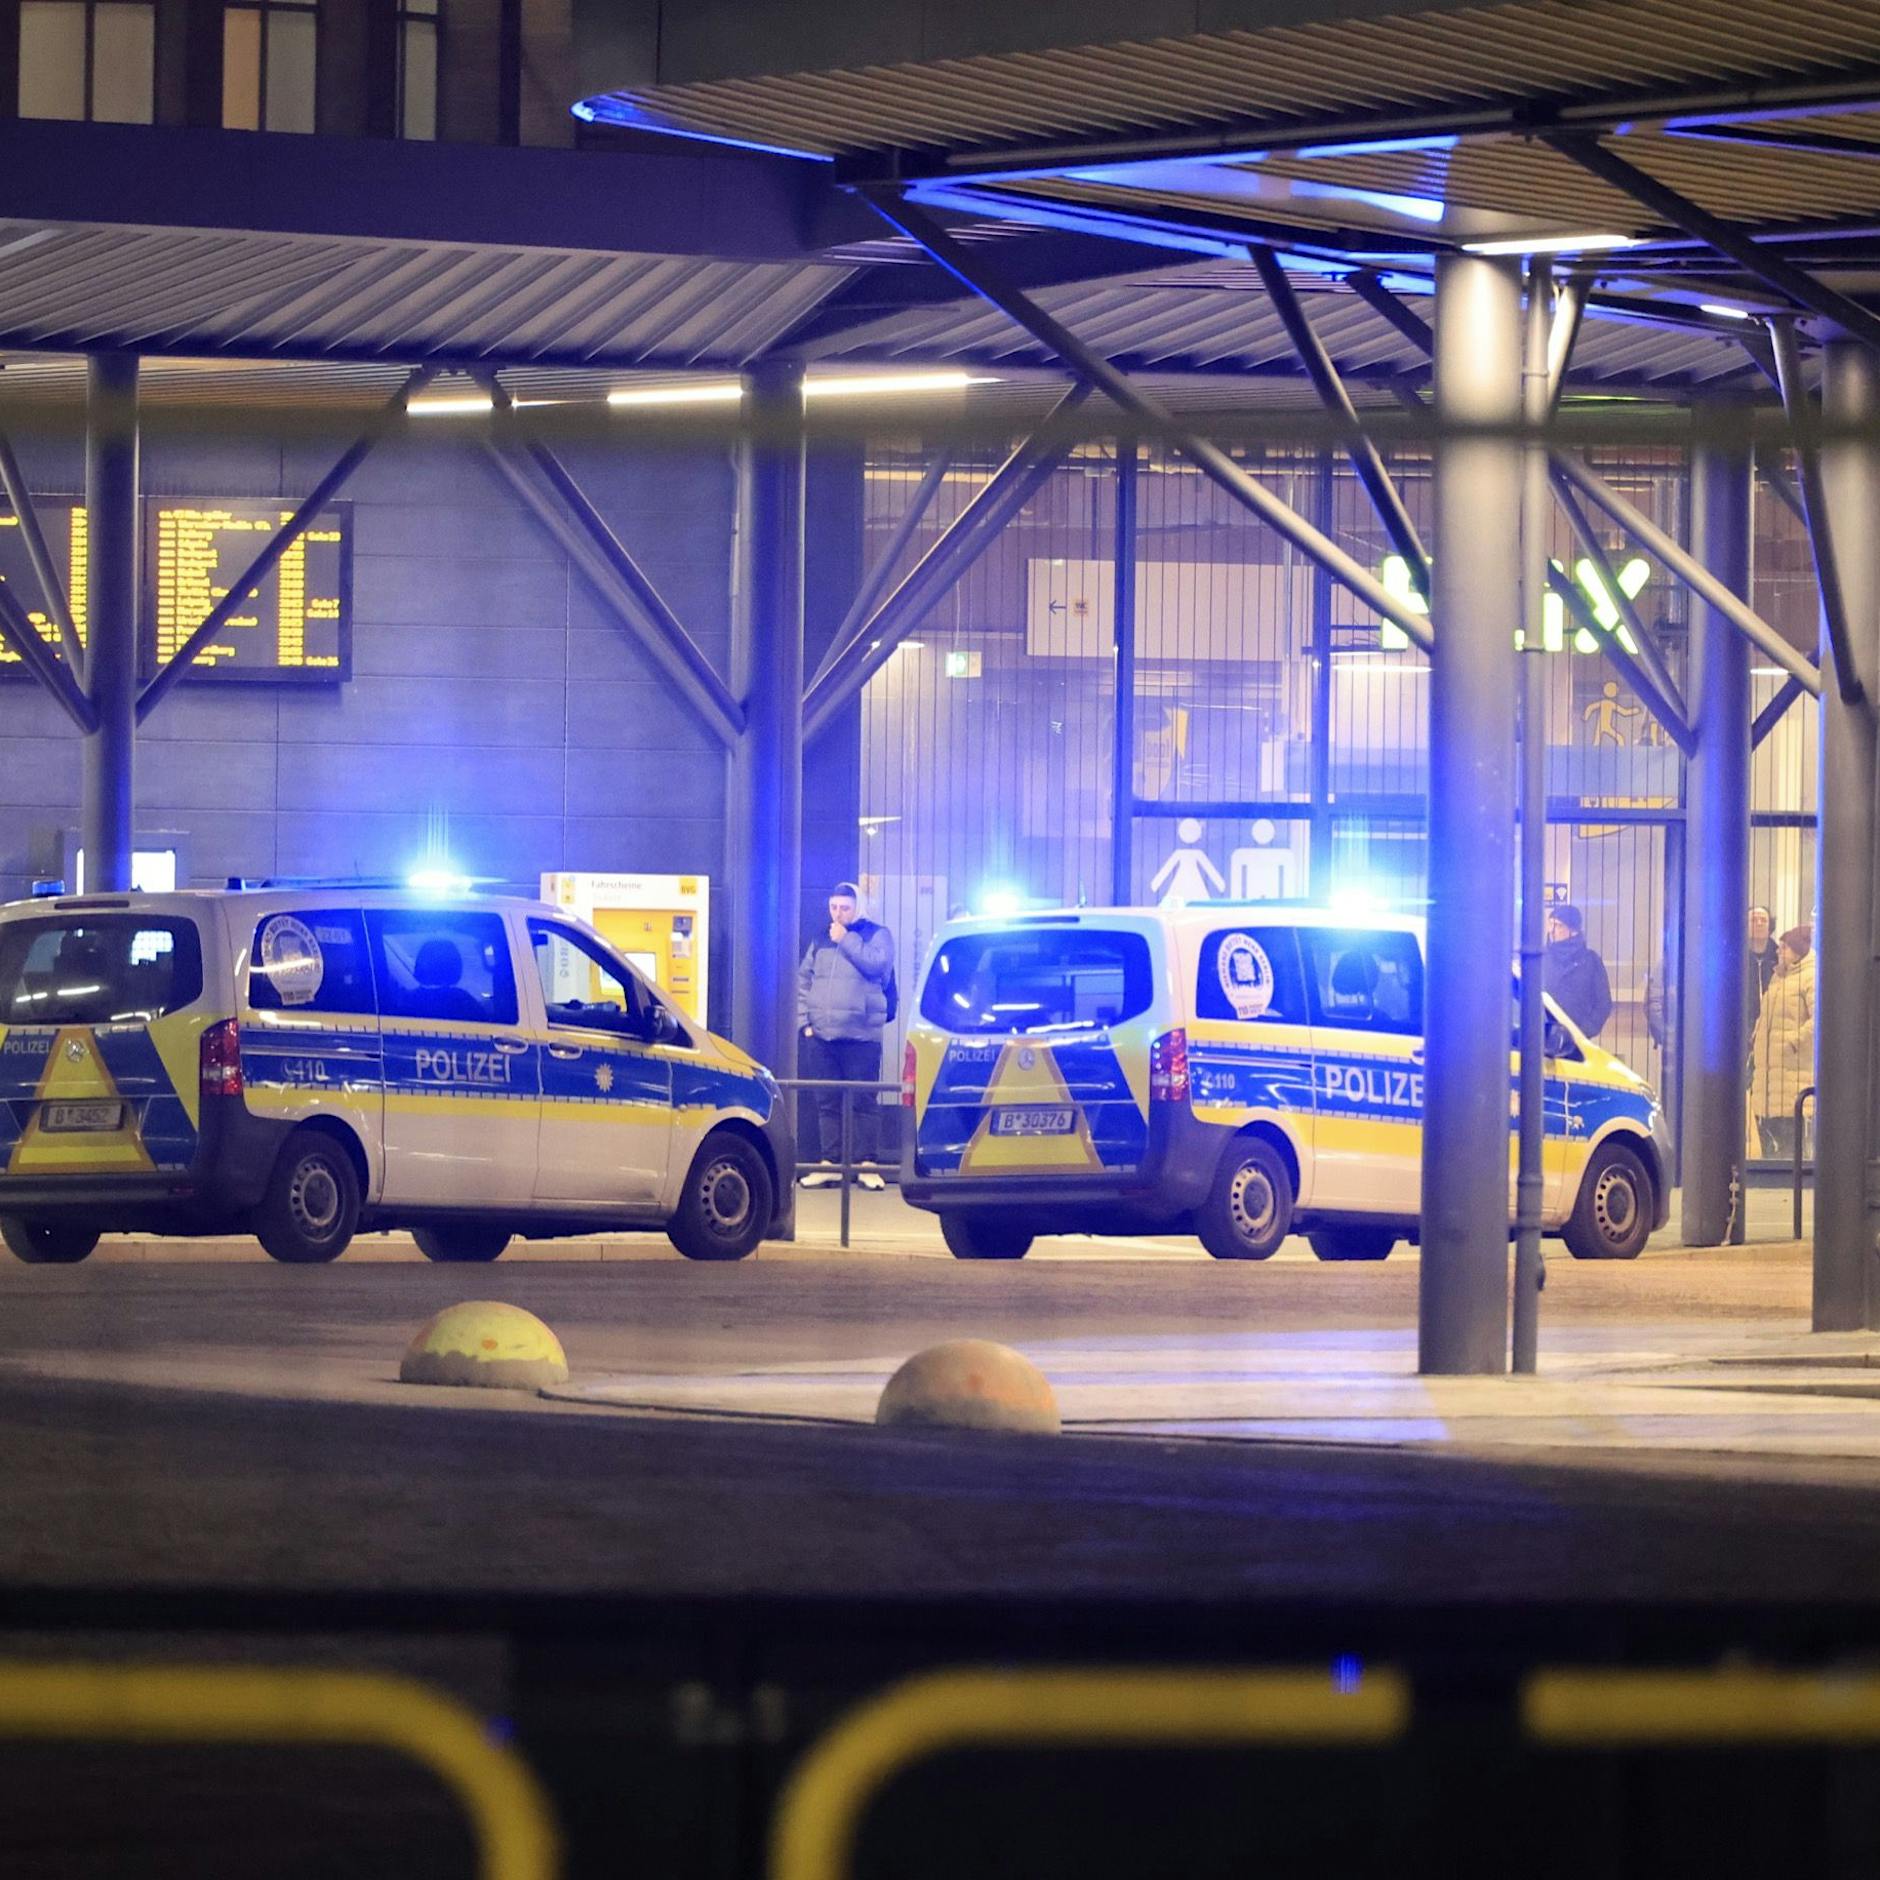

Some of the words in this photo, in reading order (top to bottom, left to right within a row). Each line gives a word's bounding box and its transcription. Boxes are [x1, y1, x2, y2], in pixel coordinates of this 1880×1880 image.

[3, 1040, 50, 1055] POLIZEI
[948, 1049, 996, 1063] POLIZEI
[415, 1048, 511, 1083] POLIZEI
[1214, 1072, 1236, 1089] 110
[1324, 1064, 1425, 1108] POLIZE
